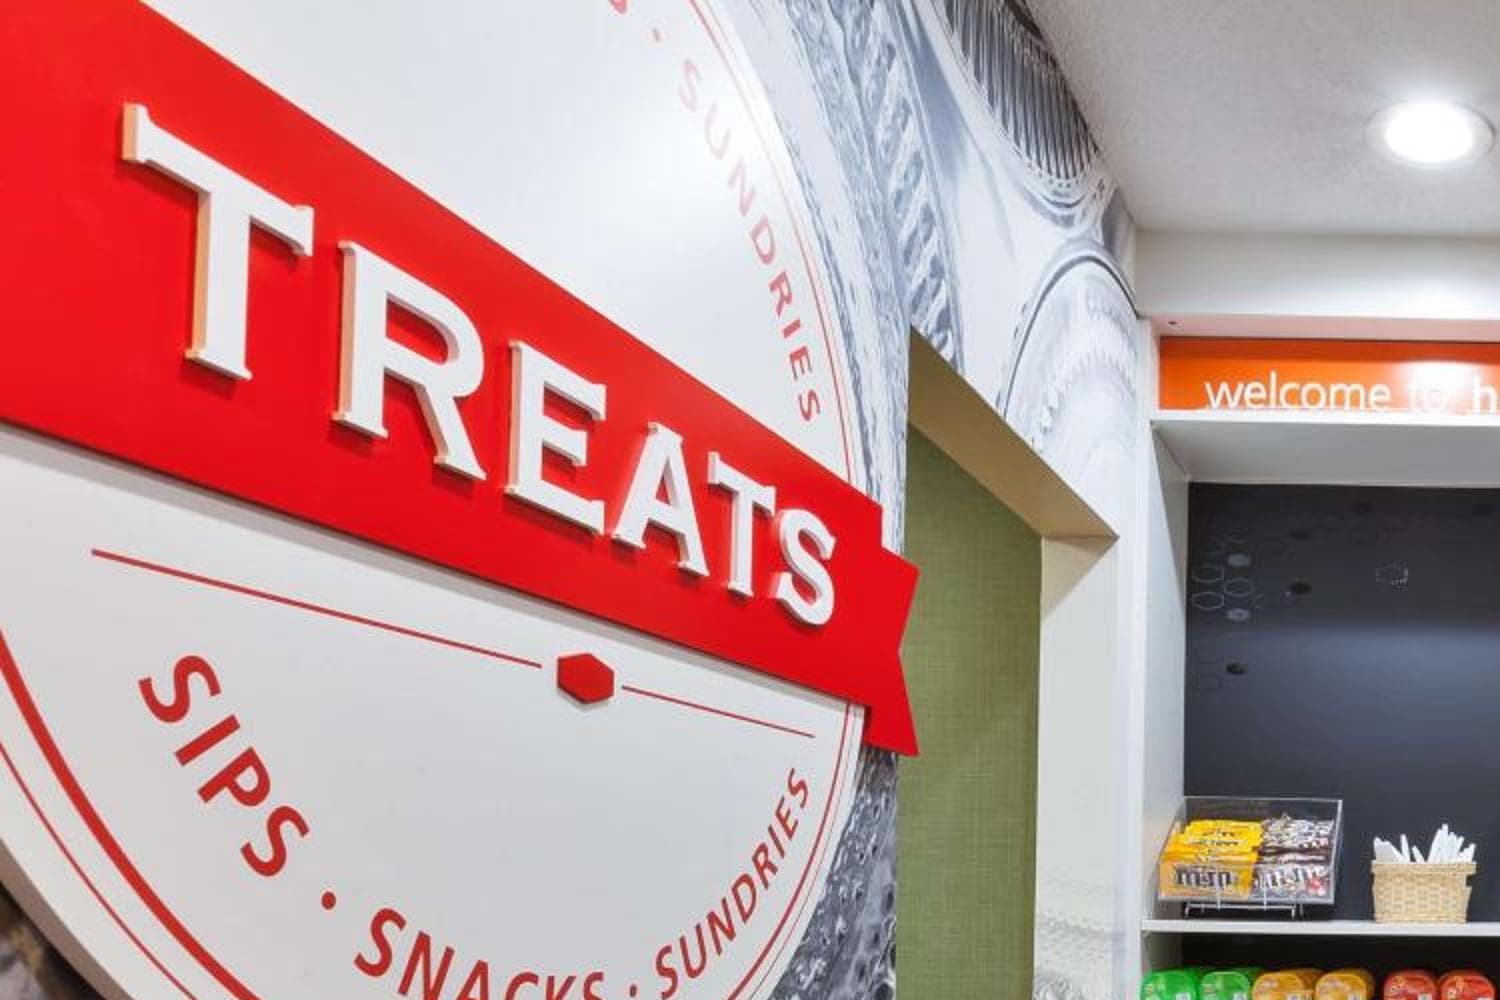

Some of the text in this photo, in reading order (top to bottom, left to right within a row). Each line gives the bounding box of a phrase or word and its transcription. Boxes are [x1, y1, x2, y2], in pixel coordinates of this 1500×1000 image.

[122, 102, 837, 627] TREATS
[677, 57, 823, 424] SUNDRIES
[1204, 370, 1391, 410] welcome
[137, 653, 311, 879] SIPS
[655, 767, 810, 1000] SUNDRIES
